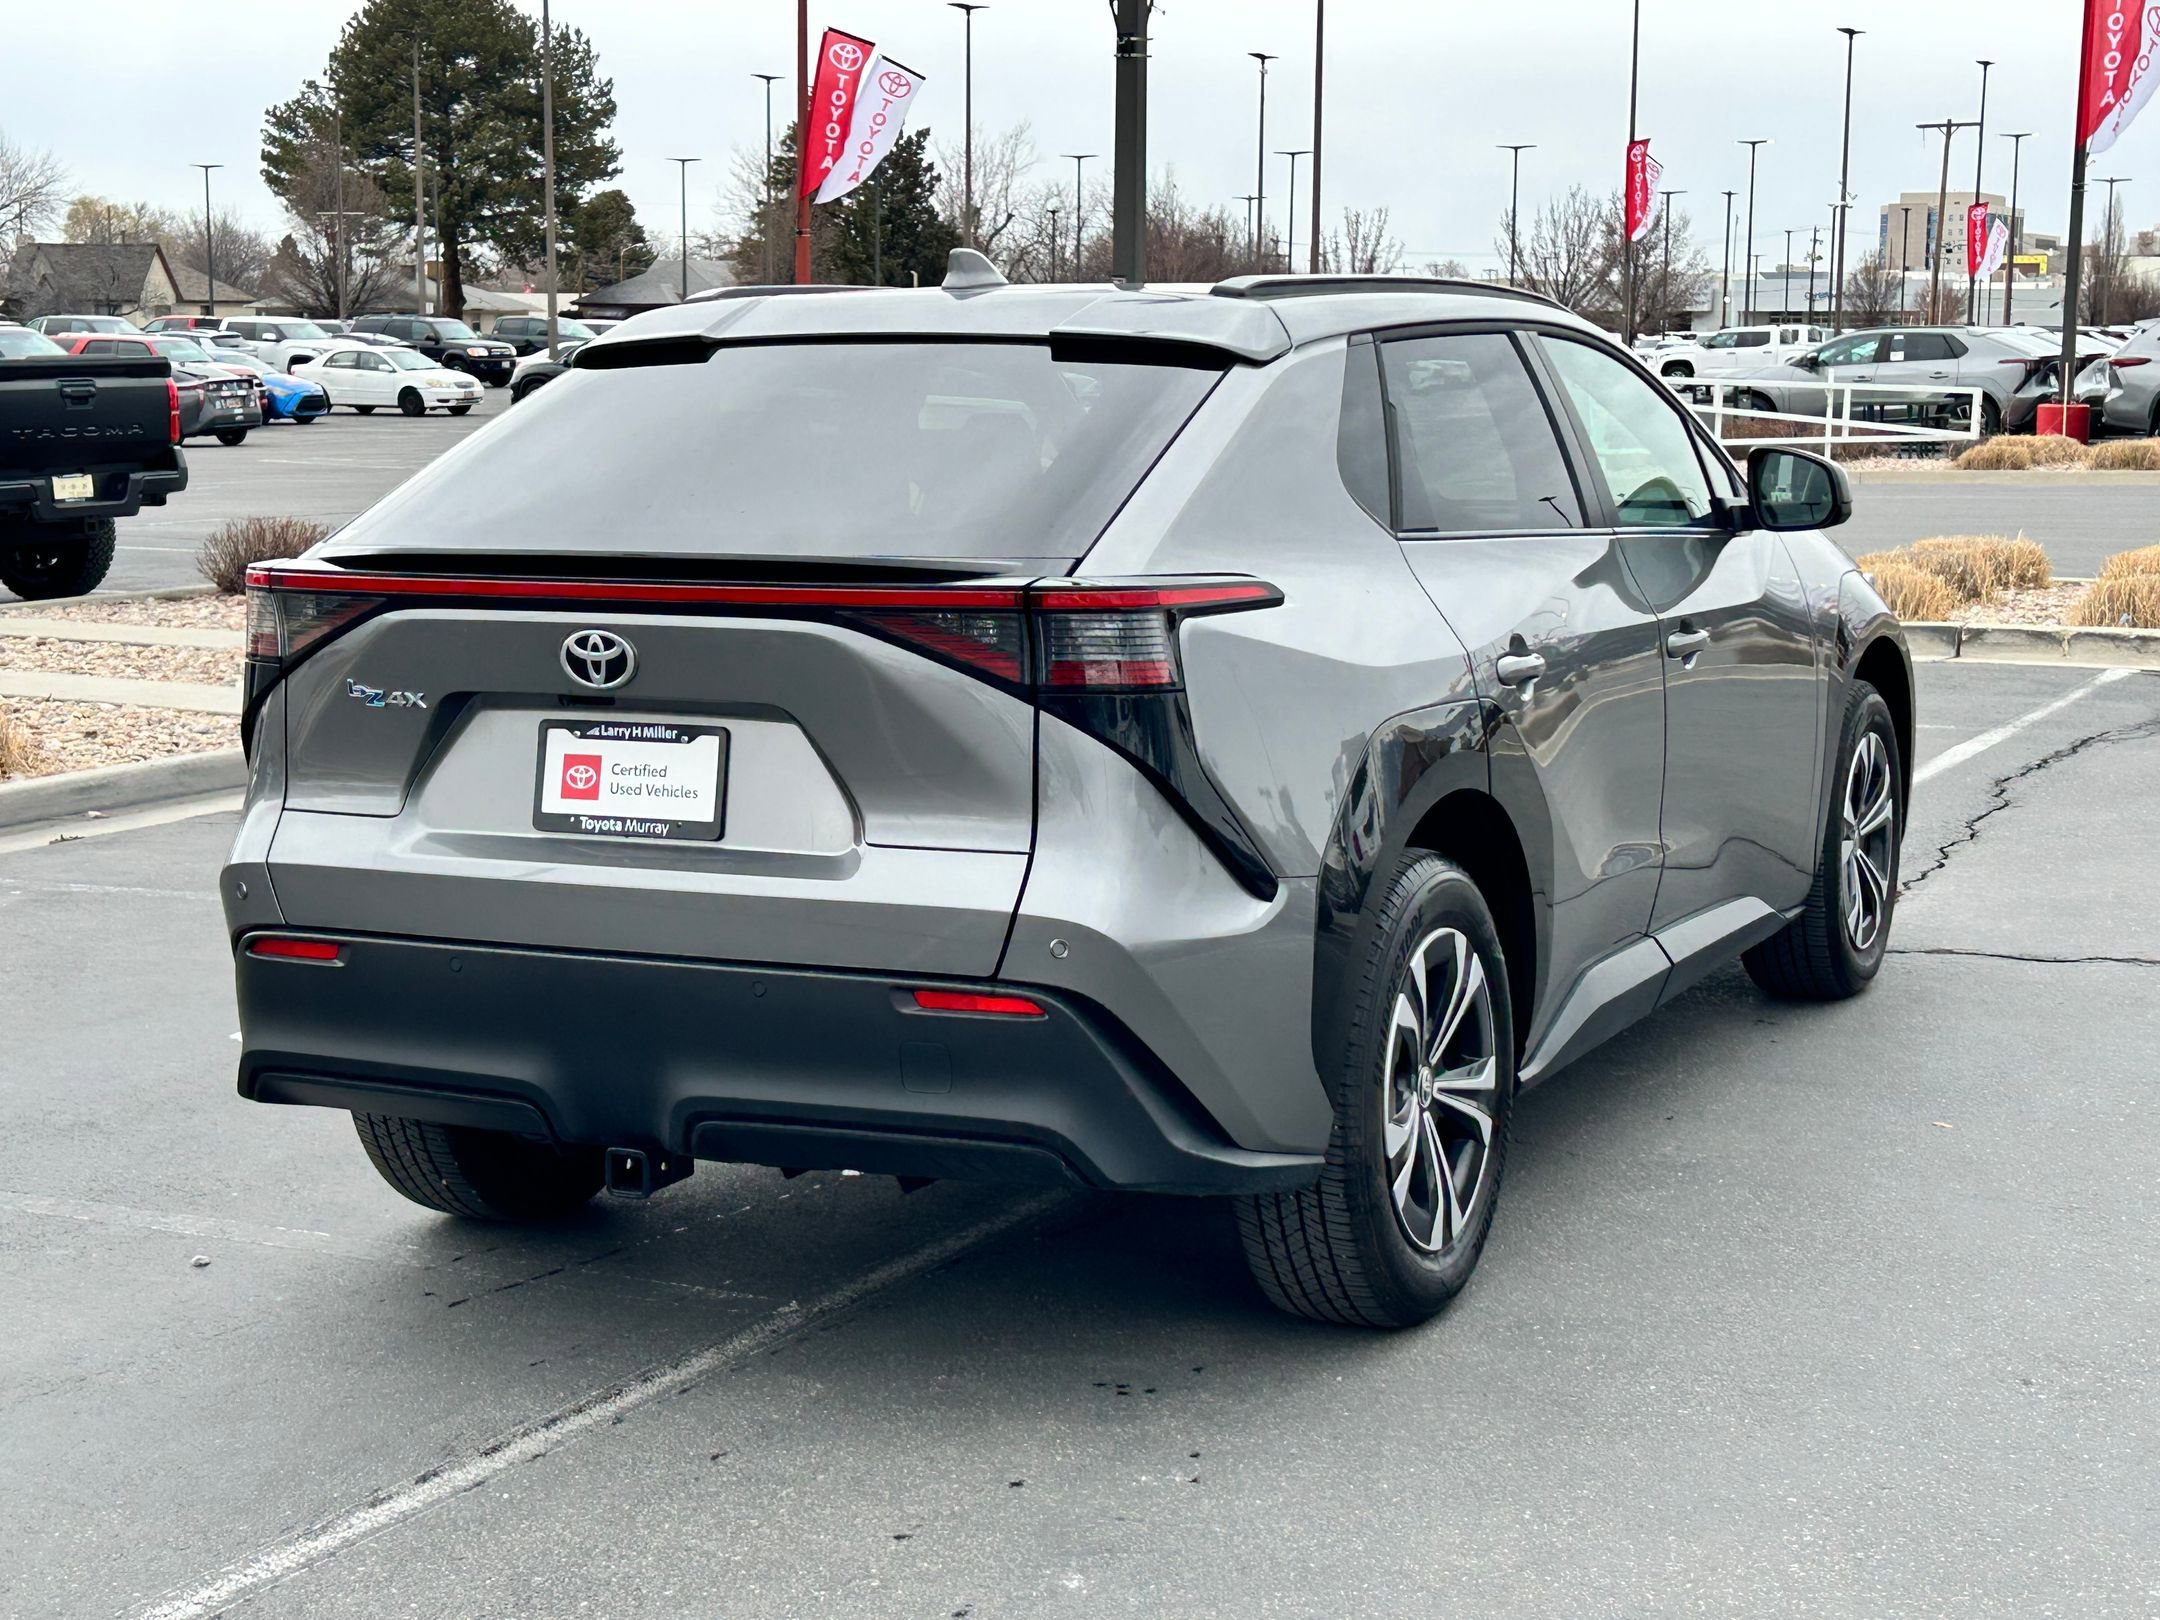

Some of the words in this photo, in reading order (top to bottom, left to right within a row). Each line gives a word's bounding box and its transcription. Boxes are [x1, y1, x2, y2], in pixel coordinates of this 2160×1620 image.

[820, 73, 849, 170] TOYOTA
[847, 97, 894, 183] TOYOTA
[1635, 162, 1643, 220] TOYOTA
[1974, 220, 1982, 265] TOYOTA
[12, 424, 144, 441] TACOMA
[601, 724, 630, 740] Larry
[632, 727, 641, 738] H
[643, 726, 678, 740] Miller
[611, 763, 668, 778] Certified
[610, 782, 642, 796] Used
[646, 783, 699, 799] Vehicles
[580, 816, 622, 833] Toyota
[624, 819, 670, 837] Murray
